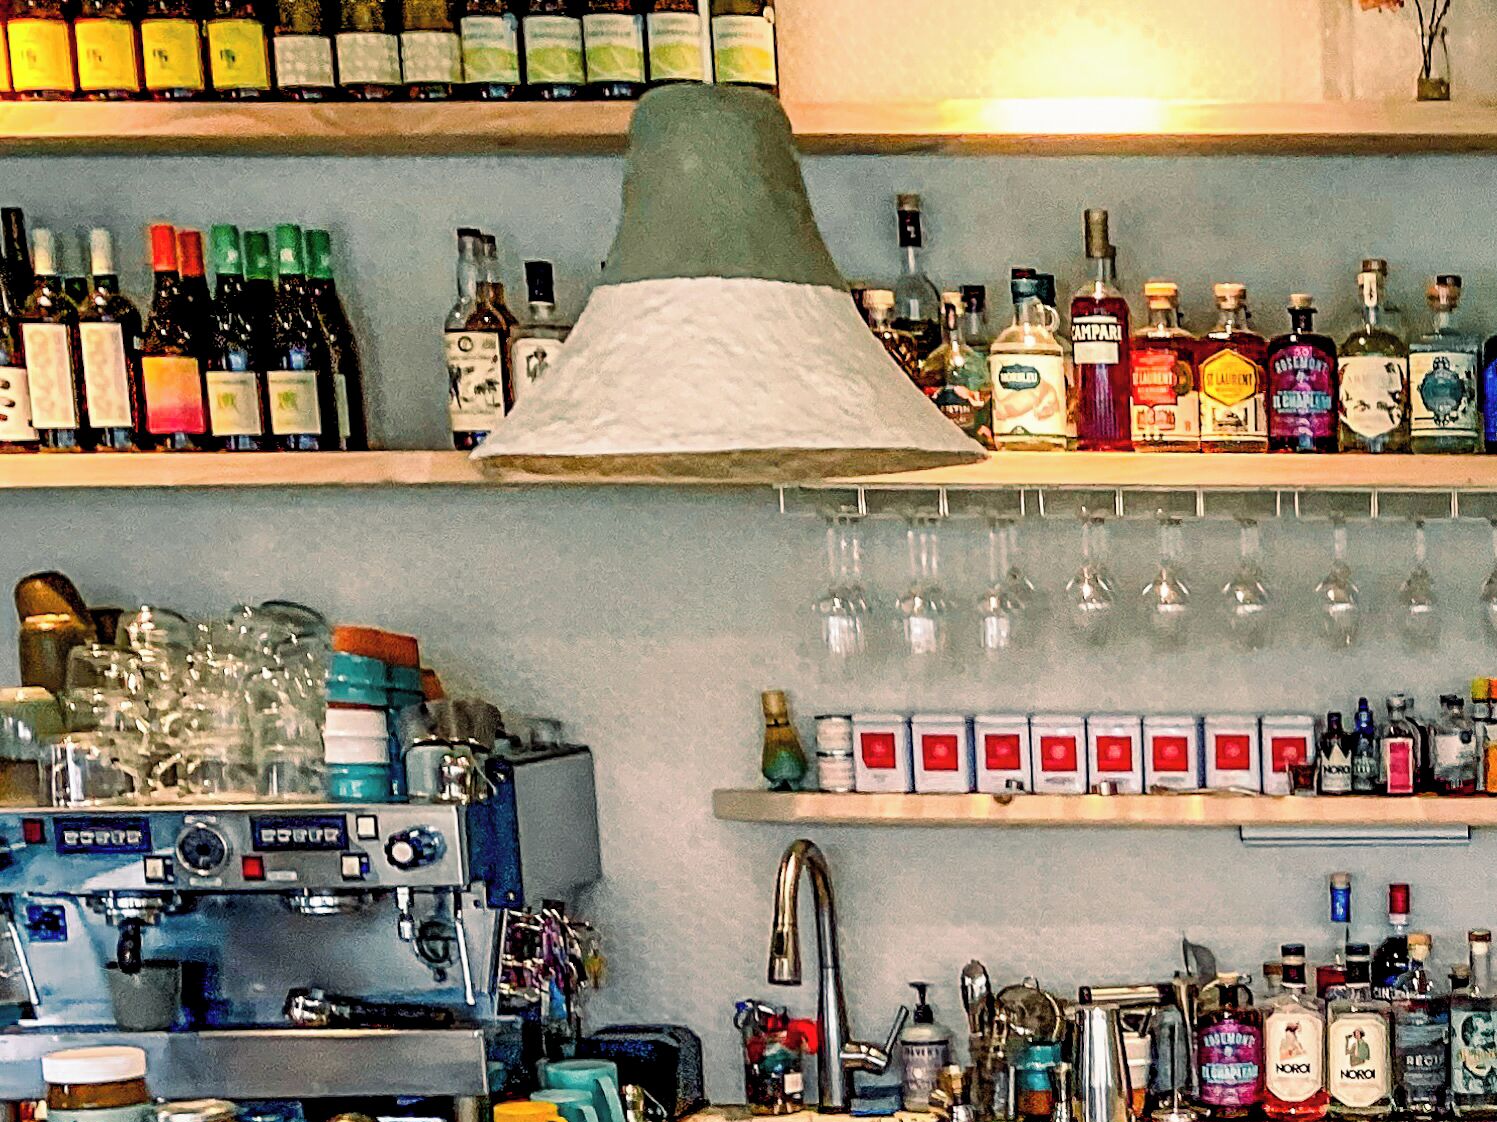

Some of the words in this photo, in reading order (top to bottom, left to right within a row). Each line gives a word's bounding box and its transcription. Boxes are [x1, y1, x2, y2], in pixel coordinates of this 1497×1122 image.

[1275, 355, 1329, 374] ROSEMONT
[1216, 373, 1253, 386] LAURENT
[1276, 1063, 1310, 1074] NOROI
[1340, 1069, 1375, 1080] NOROI
